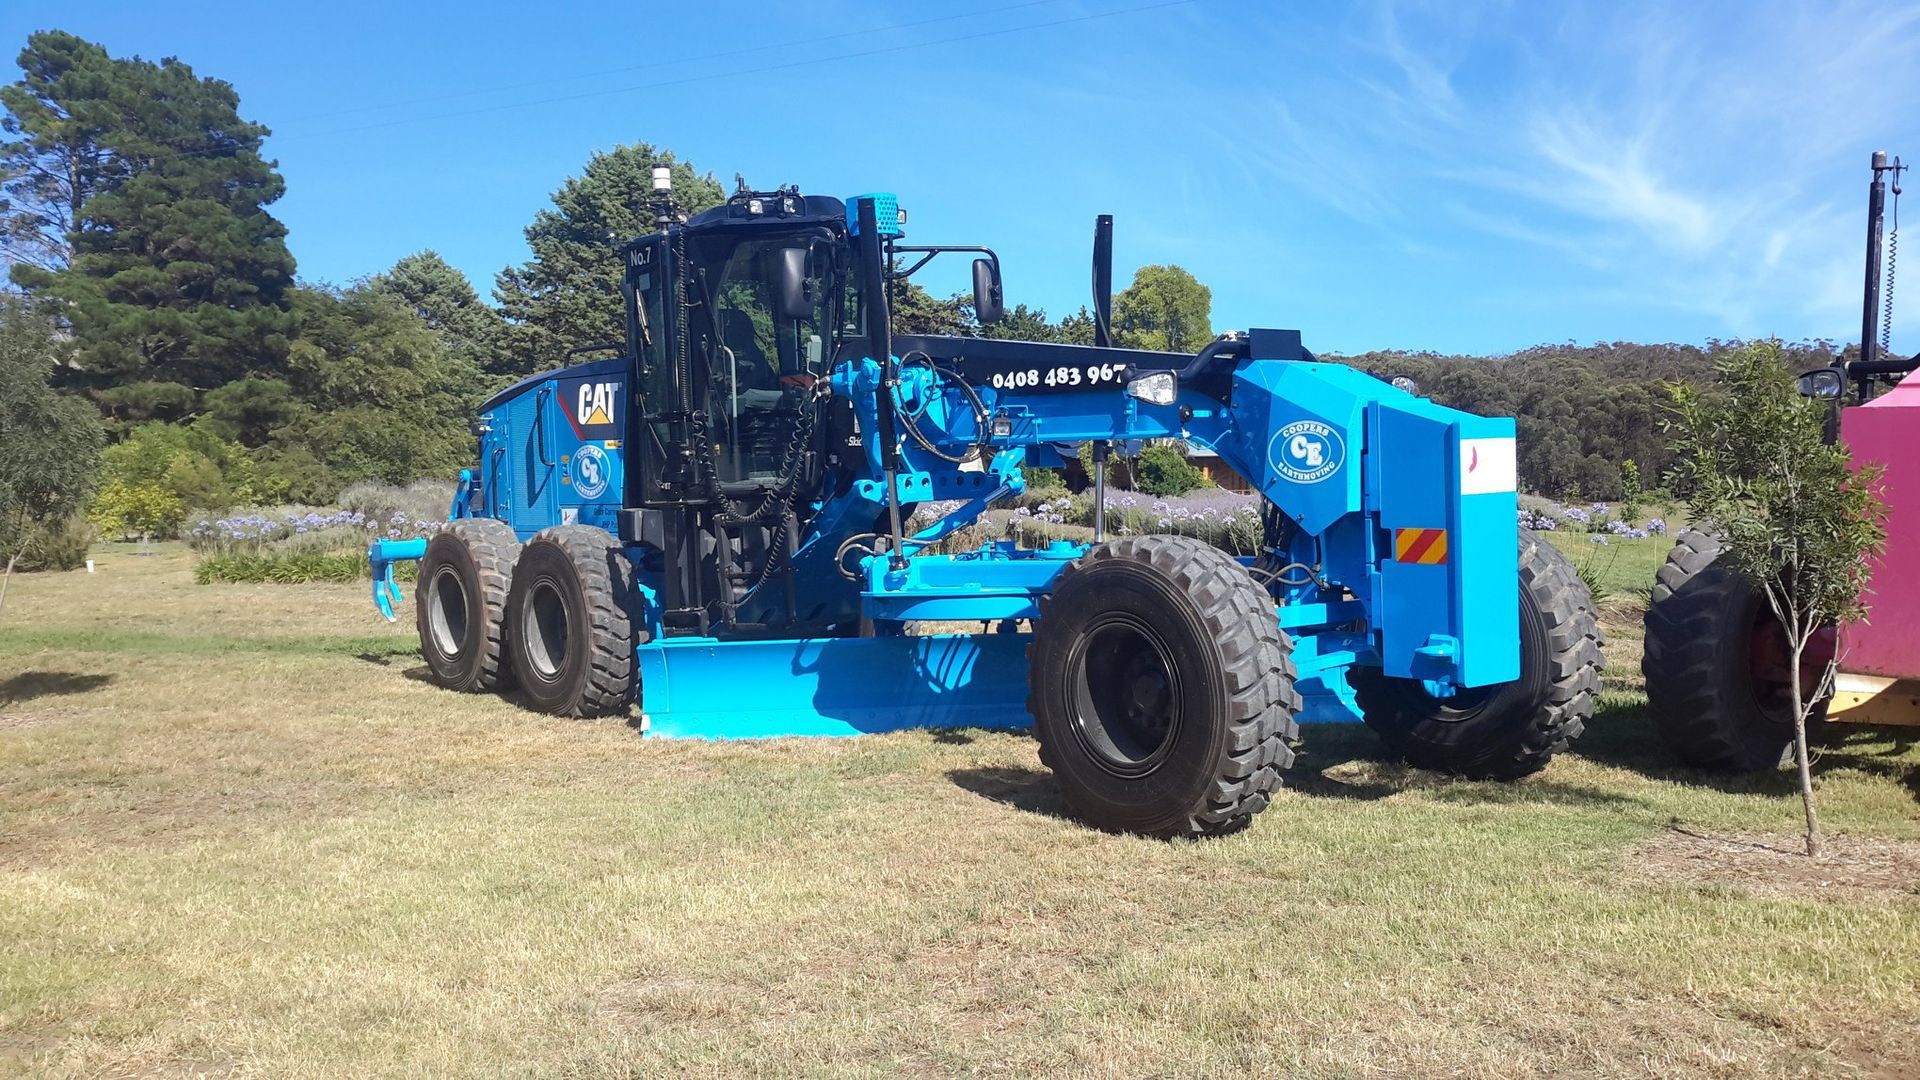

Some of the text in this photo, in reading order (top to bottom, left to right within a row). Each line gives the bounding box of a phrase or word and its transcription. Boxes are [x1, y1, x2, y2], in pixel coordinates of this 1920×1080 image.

[630, 246, 651, 267] No.7
[992, 363, 1126, 389] 0408 483 967
[578, 382, 619, 425] CAT
[1282, 423, 1330, 438] COOPERS
[1277, 461, 1335, 480] EARTHMOVING
